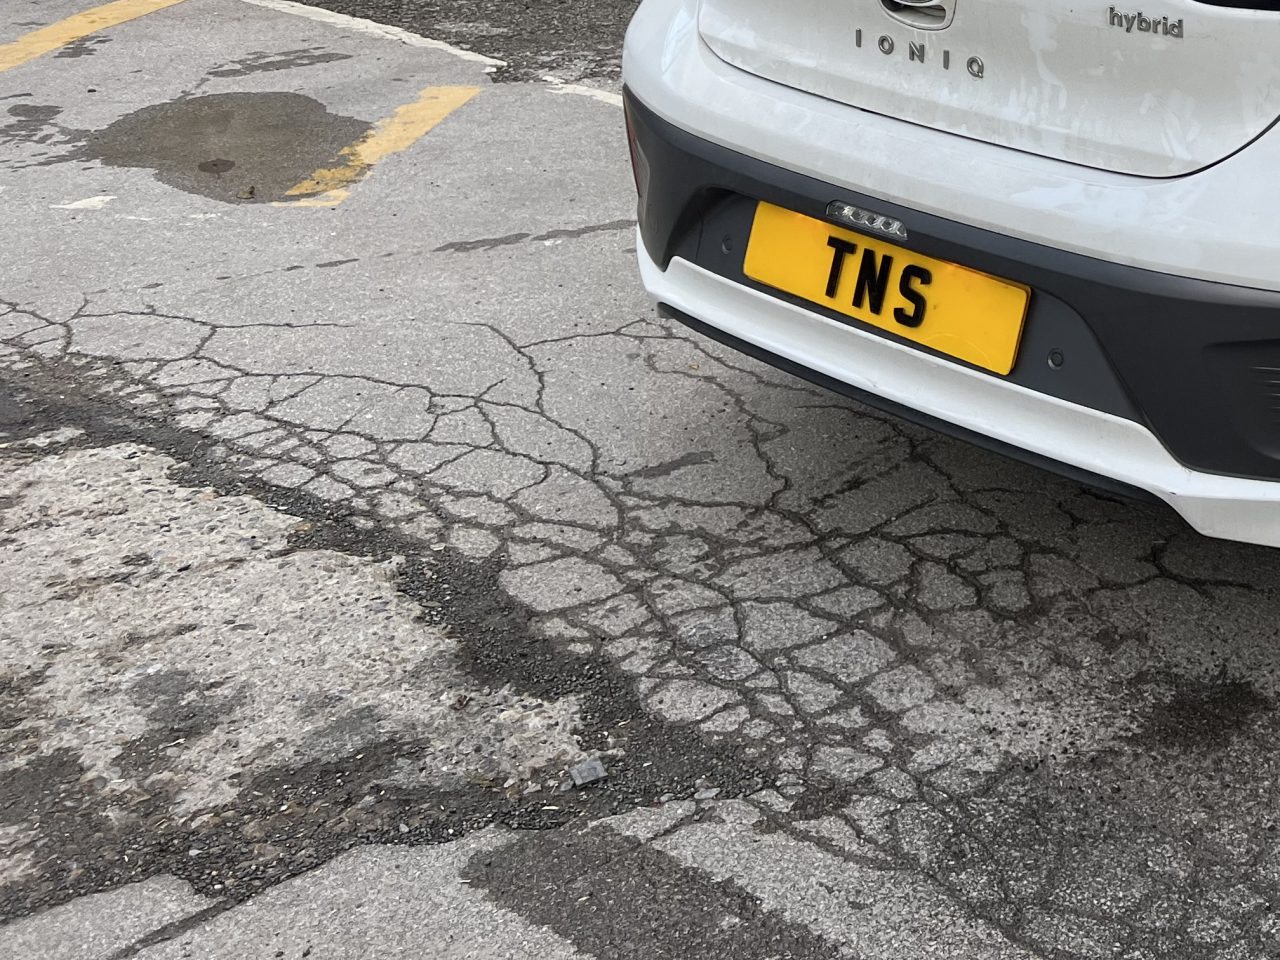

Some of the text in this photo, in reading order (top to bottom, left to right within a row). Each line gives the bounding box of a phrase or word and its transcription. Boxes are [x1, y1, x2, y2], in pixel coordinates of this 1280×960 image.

[1109, 6, 1183, 38] hybrid
[855, 28, 984, 78] IONIQ
[825, 235, 932, 328] TNS
